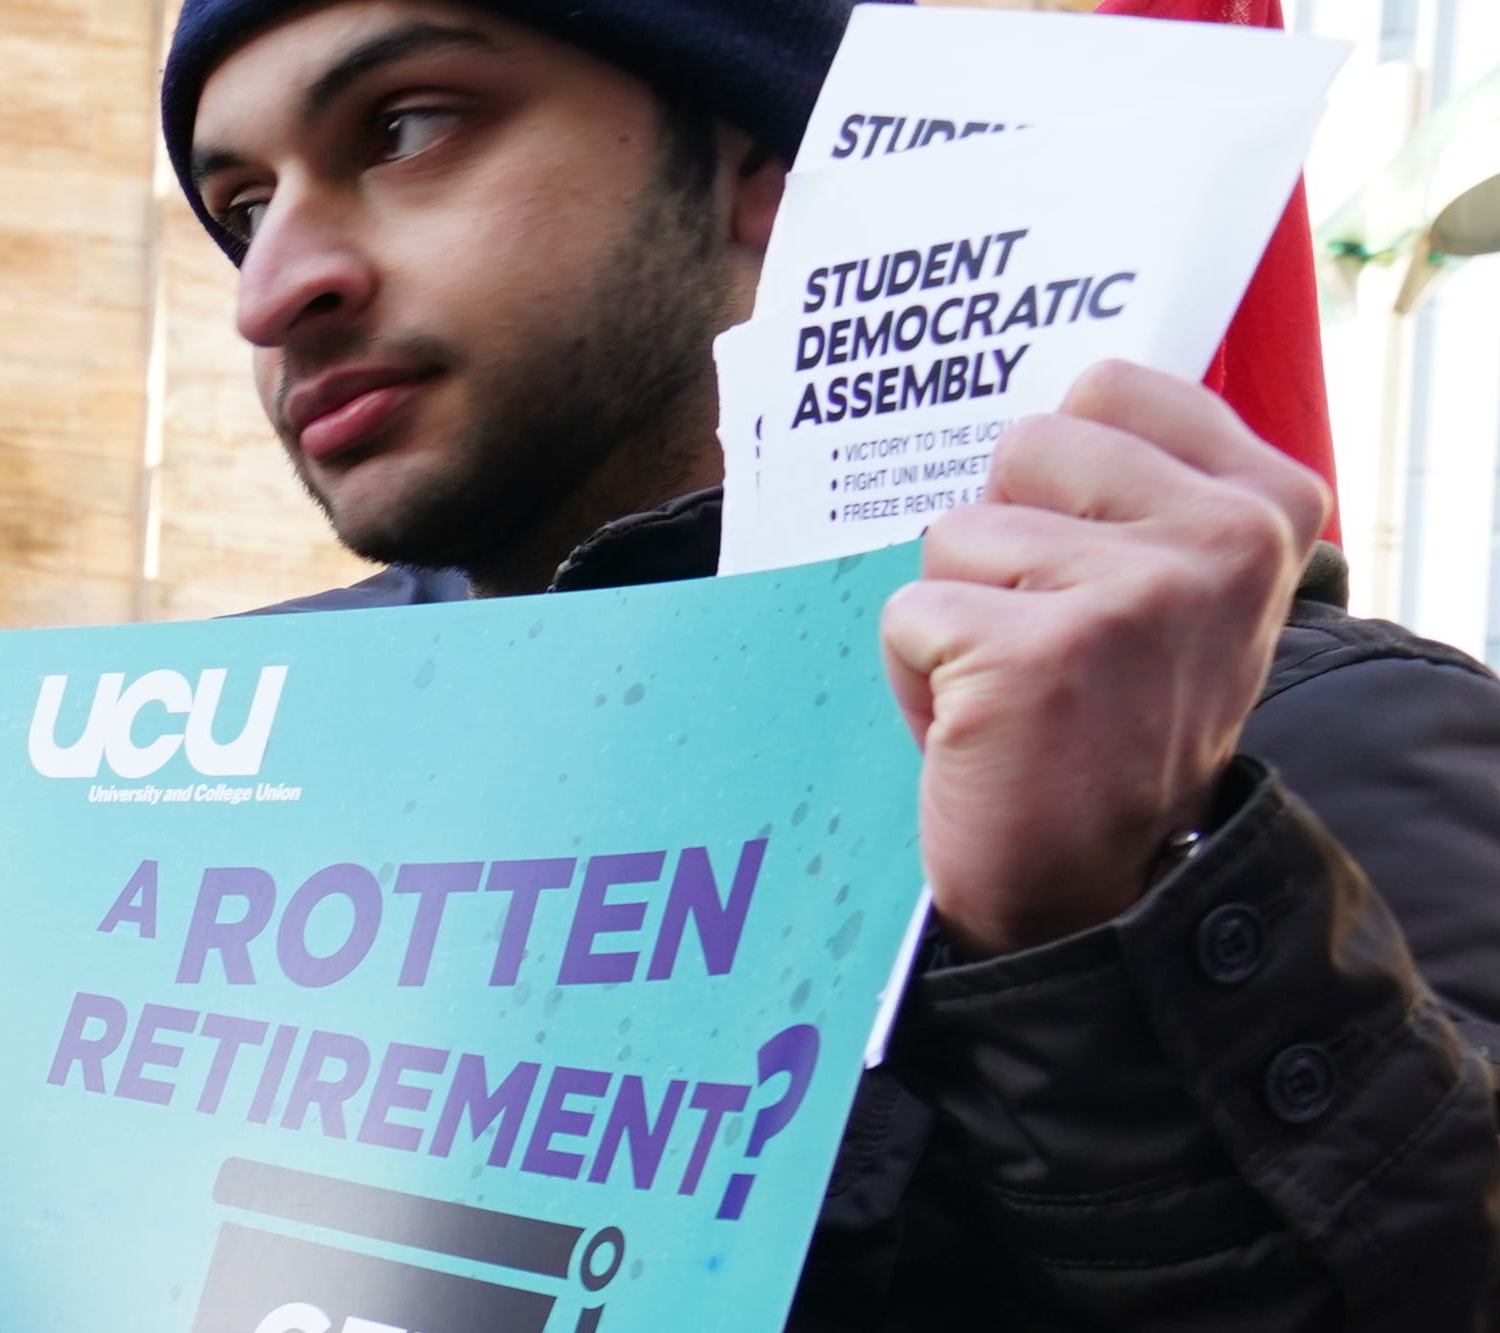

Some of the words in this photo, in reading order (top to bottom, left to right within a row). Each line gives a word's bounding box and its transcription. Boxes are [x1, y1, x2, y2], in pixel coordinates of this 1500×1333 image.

[830, 113, 1037, 159] STUD
[803, 228, 1029, 314] STUDENT
[795, 271, 1138, 372] DEMOCRATIC
[790, 344, 1030, 429] ASSEMBLY
[843, 469, 889, 494] FIGHT
[892, 464, 919, 486] UNI
[844, 435, 910, 463] VICTORY
[915, 431, 935, 452] TO
[941, 425, 971, 448] THE
[975, 419, 1012, 443] UC
[842, 497, 901, 524] FREEZE
[904, 488, 956, 516] RENTS
[28, 665, 289, 779] UCU
[87, 783, 163, 806] University
[163, 785, 190, 803] and
[193, 782, 253, 806] College
[255, 781, 302, 803] Union
[96, 859, 160, 940] A
[175, 837, 769, 989] ROTTEN
[46, 991, 821, 1222] RETIREMENT?
